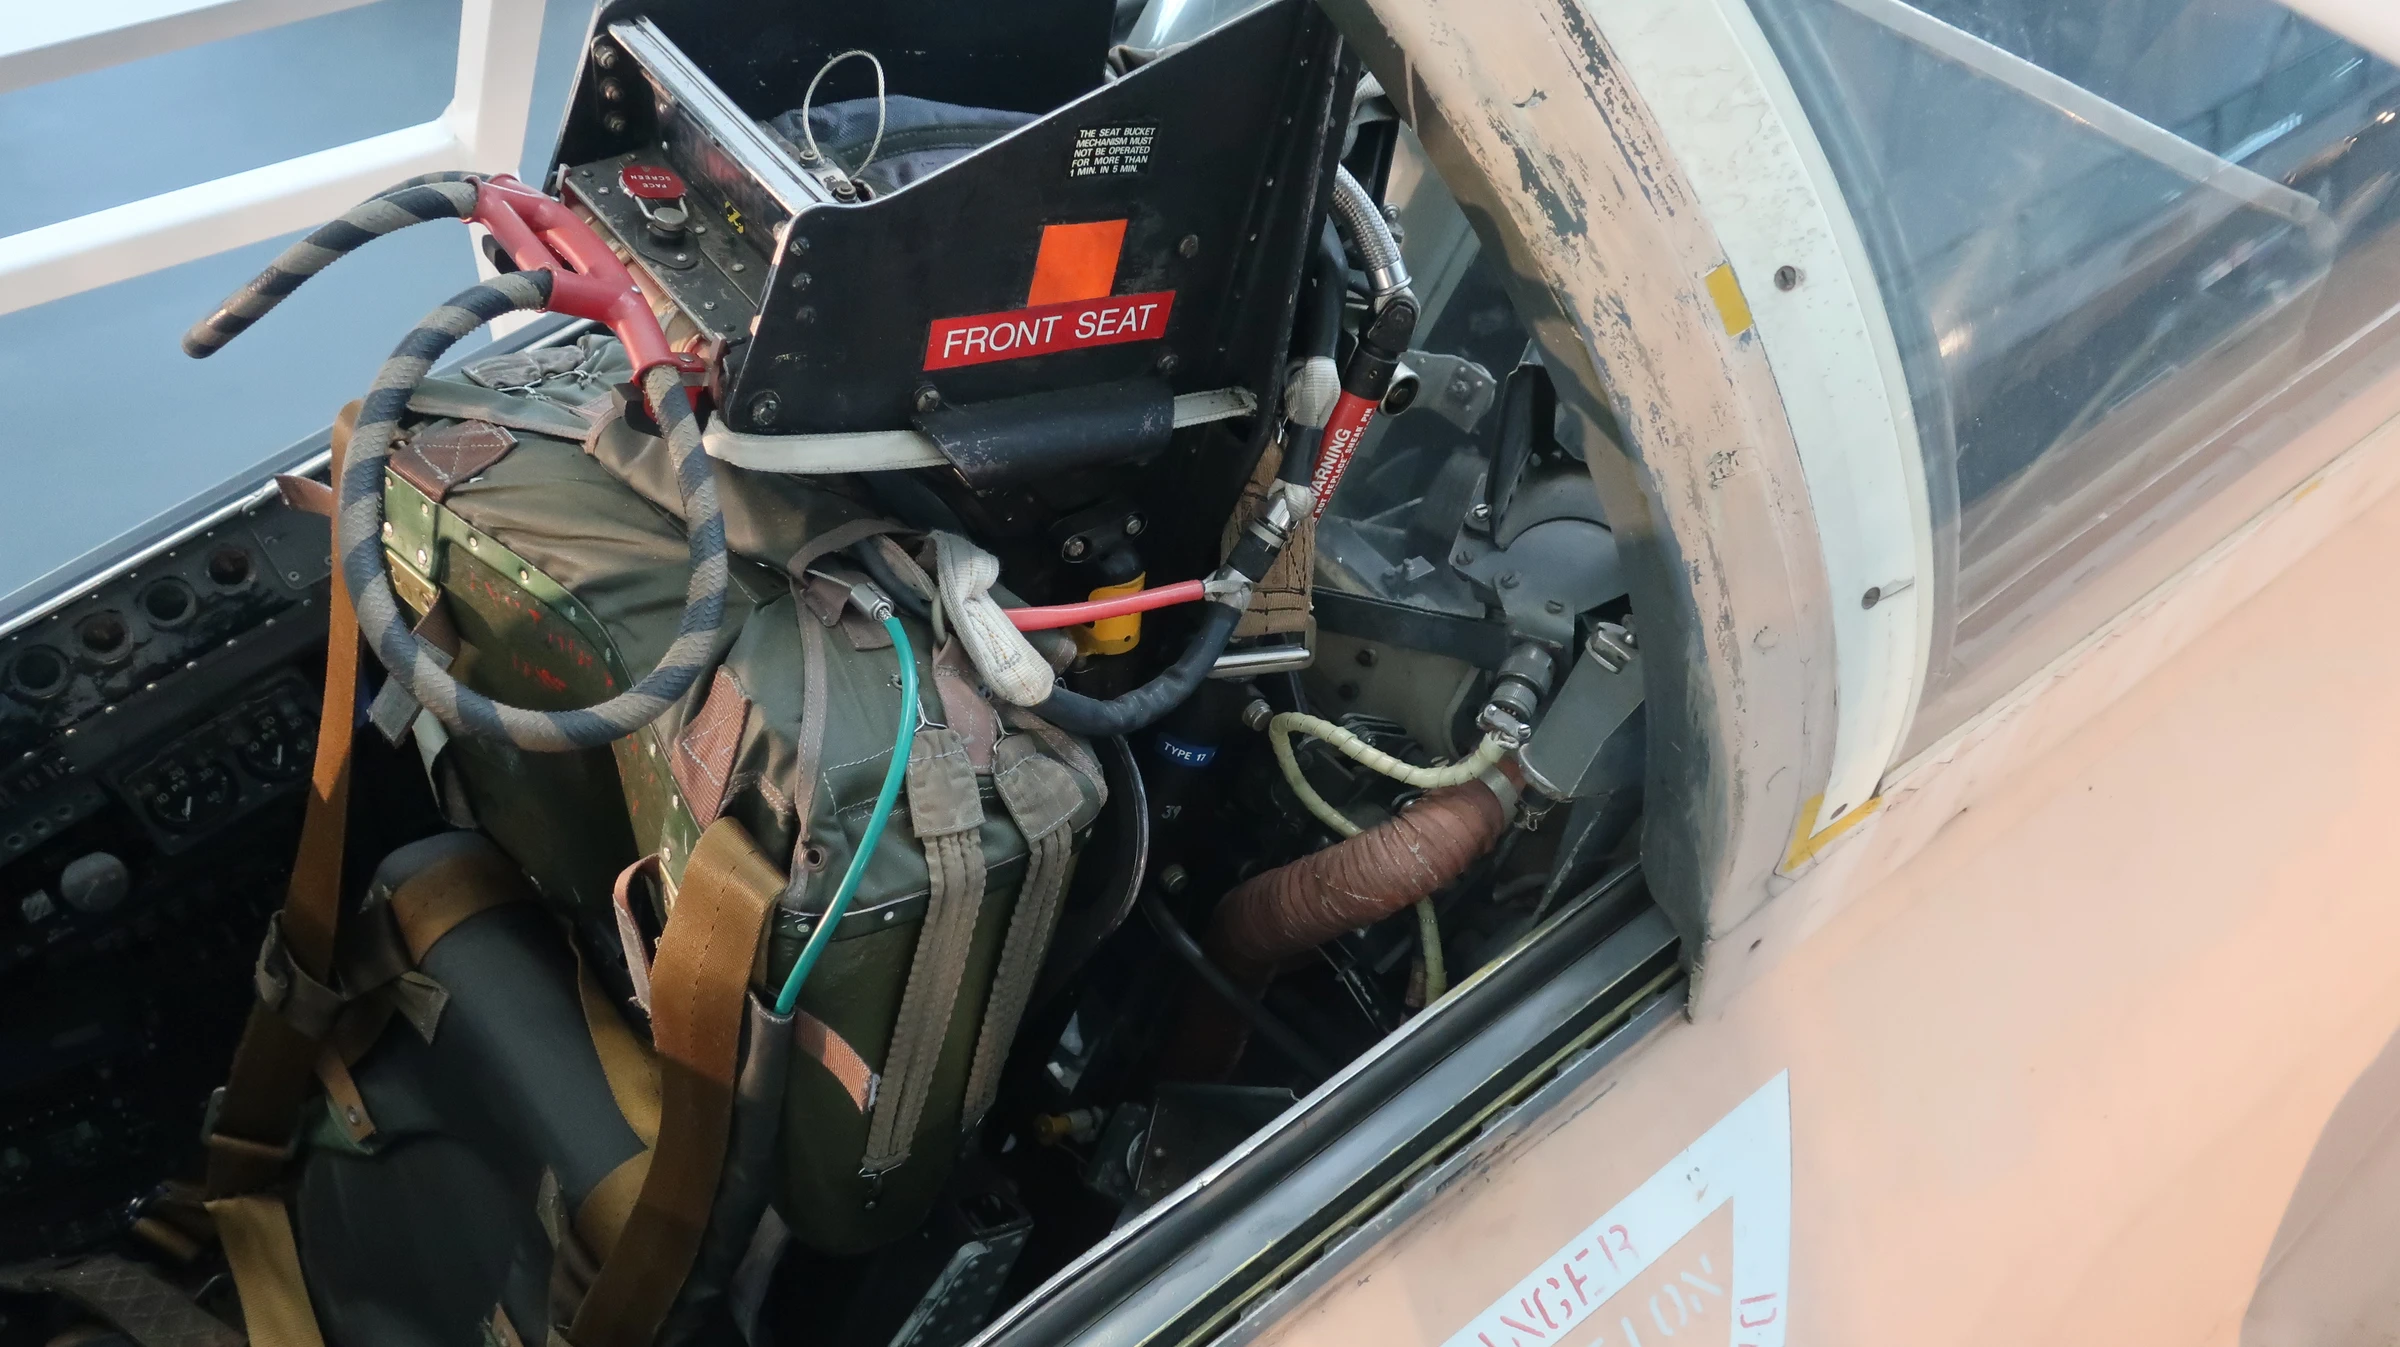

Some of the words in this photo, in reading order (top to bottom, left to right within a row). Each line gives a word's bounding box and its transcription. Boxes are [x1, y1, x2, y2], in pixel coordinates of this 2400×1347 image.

[1080, 129, 1097, 138] THE
[1099, 127, 1121, 137] SEAT
[1124, 127, 1156, 136] BUCKET
[1076, 137, 1128, 148] MECHANISM
[1129, 136, 1153, 145] MUST
[1074, 148, 1093, 157] NOT
[1095, 147, 1107, 156] BE
[1108, 146, 1151, 155] OPERATED
[1071, 158, 1090, 168] FOR
[1094, 156, 1120, 165] MORE
[1124, 155, 1148, 164] THAN
[1070, 168, 1075, 177] 1
[1077, 166, 1097, 176] MIN.
[1099, 165, 1110, 174] IN
[1112, 164, 1118, 173] 5
[1119, 164, 1138, 173] MIN.
[943, 315, 1063, 359] FRONT
[1074, 303, 1158, 339] SEAT
[1315, 498, 1328, 514] NOT
[1324, 458, 1348, 495] REPLACE
[1345, 425, 1364, 454] SHEAR
[1360, 407, 1373, 422] PIN
[1164, 741, 1193, 760] TYPE
[1196, 753, 1207, 762] 17
